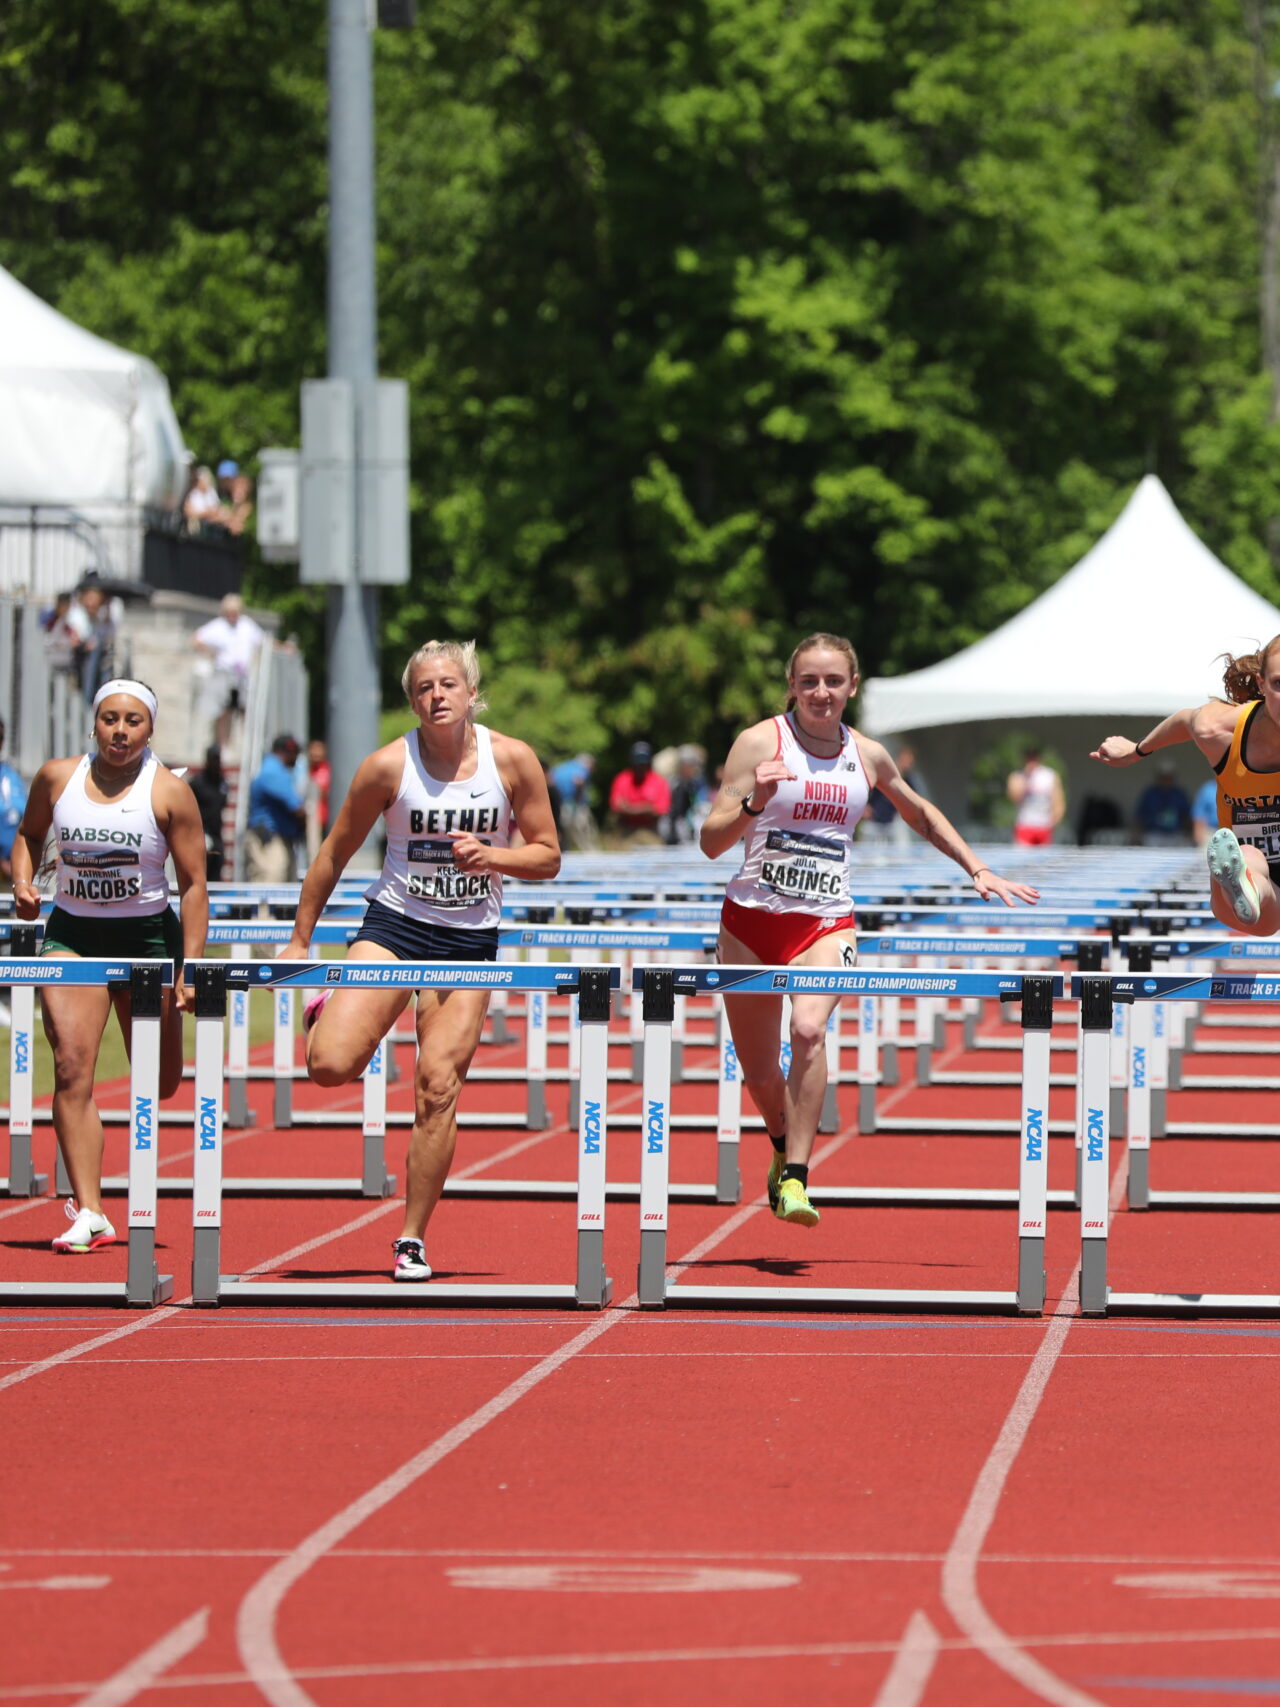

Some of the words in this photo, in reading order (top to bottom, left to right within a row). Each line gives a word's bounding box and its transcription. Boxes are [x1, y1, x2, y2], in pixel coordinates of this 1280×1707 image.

[805, 780, 848, 804] NORTH
[411, 807, 499, 834] BETHEL
[793, 802, 849, 825] CENTRAL
[60, 827, 143, 847] BABSON
[793, 857, 817, 870] JULIA
[64, 877, 140, 900] JACOBS
[408, 874, 491, 898] SEALOCK
[762, 862, 842, 895] BABINEC
[216, 929, 239, 939] FIELD
[240, 930, 294, 941] CHAMPIONS
[539, 933, 565, 943] TRACK
[574, 934, 596, 943] FIELD
[598, 934, 669, 945] CHAMPIONSHIPS
[895, 940, 924, 951] TRACK
[929, 941, 954, 952] FIELD
[955, 942, 1025, 952] CHAMPIONSHIPS
[2, 966, 63, 978] PIONSHIPS
[230, 969, 249, 977] GILL
[347, 970, 381, 981] TRACK
[383, 970, 390, 982] &
[392, 970, 421, 981] FIELD
[424, 971, 512, 982] CHAMPIONSHIPS
[794, 976, 827, 987] TRACK
[828, 976, 835, 988] &
[837, 977, 866, 988] FIELD
[869, 978, 957, 990] CHAMPIONSHIPS
[1231, 983, 1264, 995] TRACK
[1265, 984, 1272, 995] &
[16, 1032, 28, 1072] NCAA
[724, 1040, 736, 1082] NCAA
[1133, 1048, 1145, 1087] NCAA
[136, 1097, 151, 1149] NCAA
[200, 1097, 216, 1150] NCAA
[585, 1101, 600, 1153] NCAA
[648, 1101, 663, 1153] NCAA
[1026, 1109, 1042, 1160] NCAA
[1088, 1109, 1103, 1161] NCAA
[643, 1213, 664, 1221] GILL
